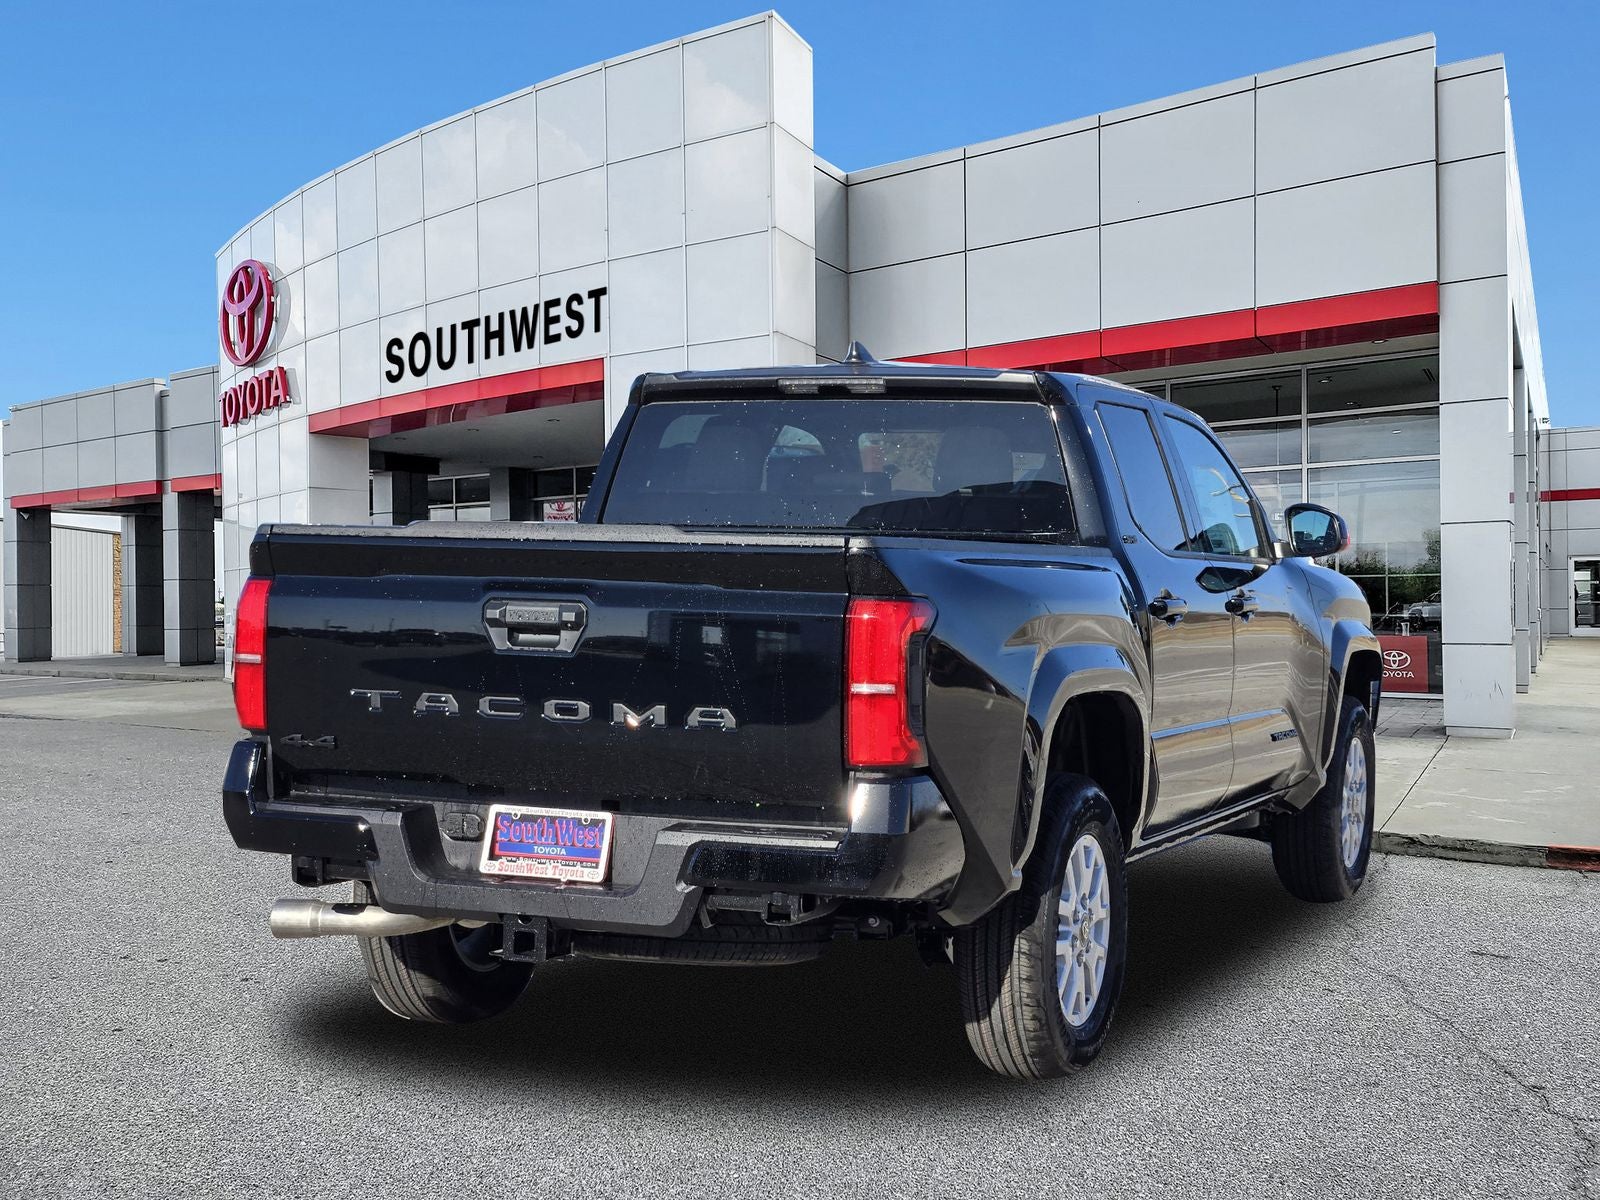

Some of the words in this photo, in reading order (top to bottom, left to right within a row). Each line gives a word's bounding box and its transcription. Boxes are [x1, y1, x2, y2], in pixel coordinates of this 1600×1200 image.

[385, 286, 608, 384] SOUTHWEST
[218, 365, 291, 428] TOYOTA
[1382, 670, 1415, 679] OYOTA
[349, 687, 738, 732] TACOMA
[533, 846, 566, 856] TOYOTA
[551, 864, 585, 879] Toyota
